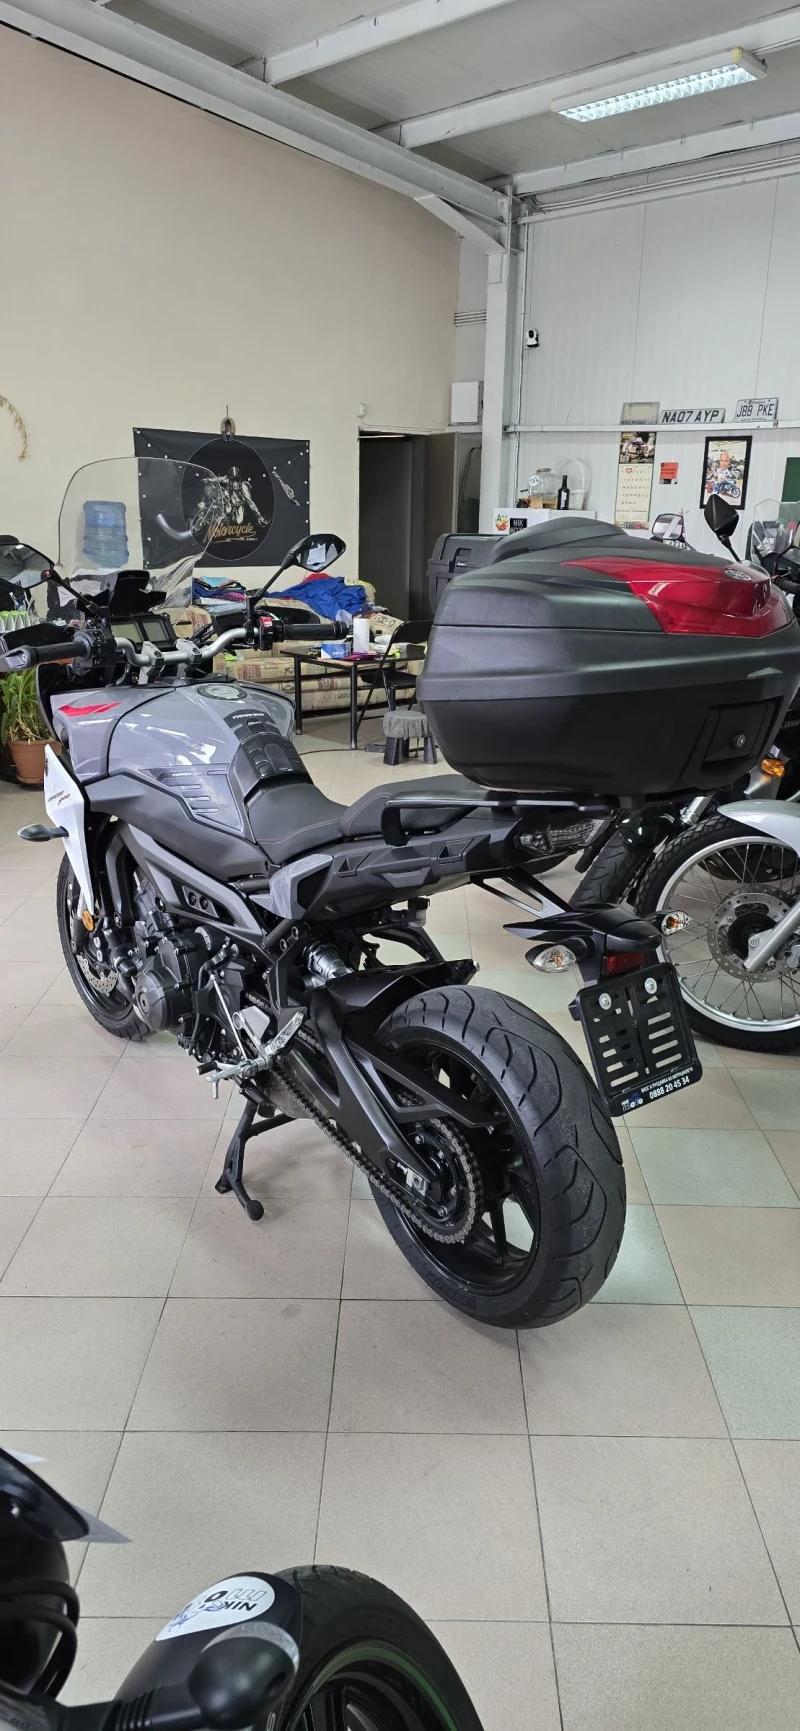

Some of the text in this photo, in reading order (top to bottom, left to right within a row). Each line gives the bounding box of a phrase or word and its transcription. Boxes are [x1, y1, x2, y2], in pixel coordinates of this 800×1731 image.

[661, 410, 719, 423] NA07 AYP
[736, 403, 775, 418] J88 PKE
[203, 521, 257, 543] Motorcycle
[649, 1075, 690, 1099] 0888 20 45 34
[222, 1600, 257, 1612] NIK
